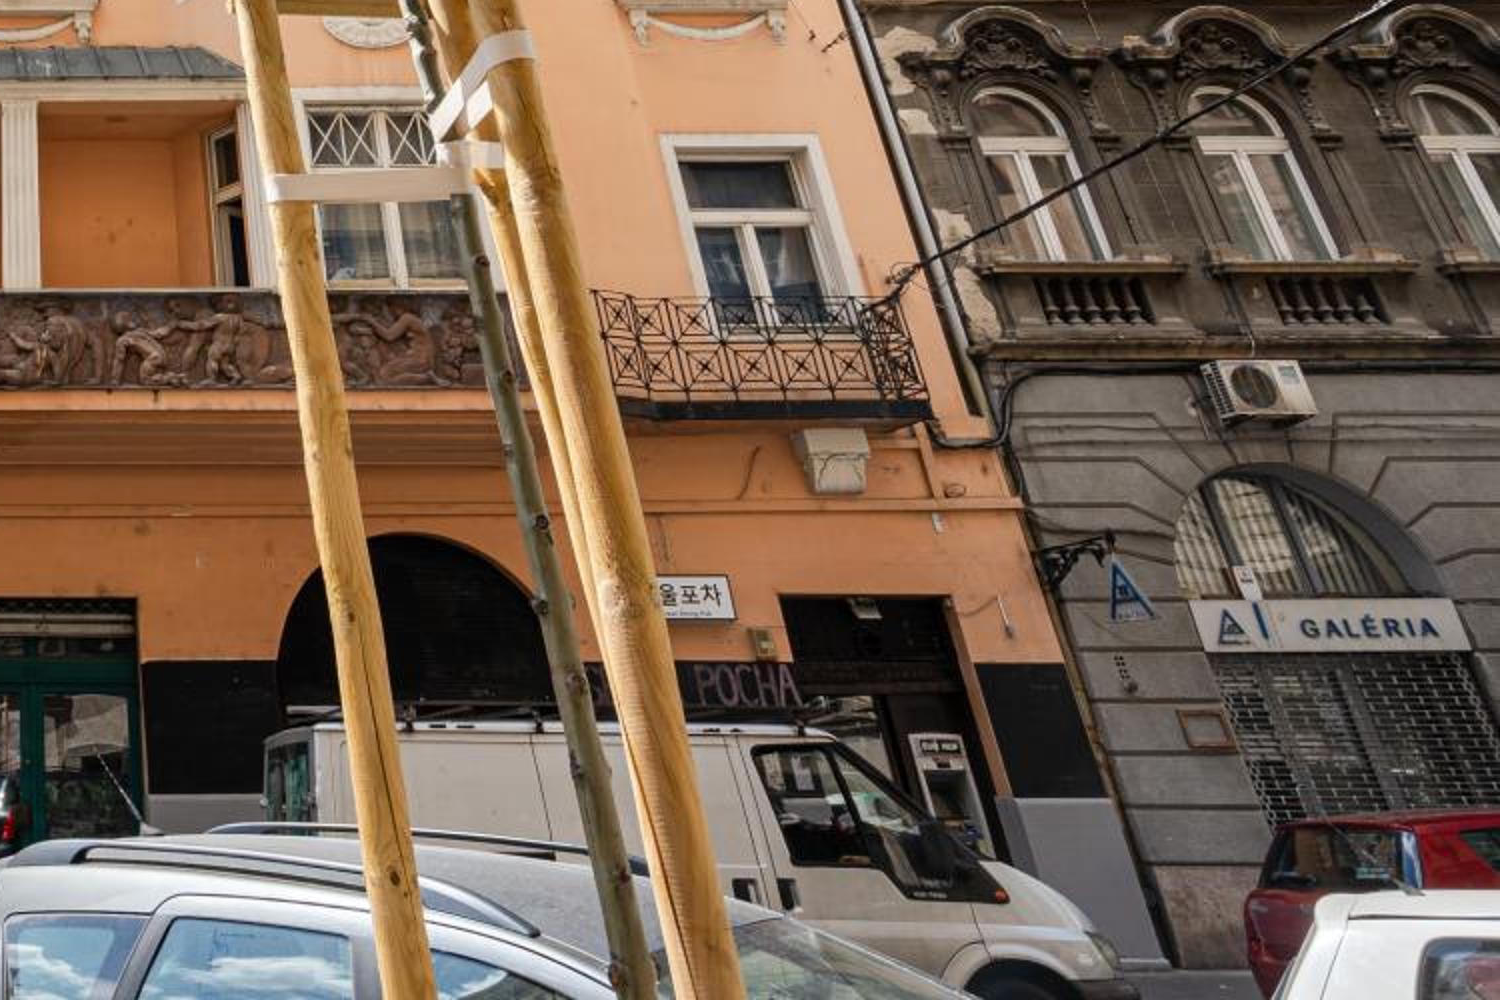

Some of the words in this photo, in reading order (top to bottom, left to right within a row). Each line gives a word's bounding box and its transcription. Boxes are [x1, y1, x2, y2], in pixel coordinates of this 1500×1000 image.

[660, 583, 721, 607] 울포차
[1299, 614, 1440, 639] GALÉRIA
[694, 664, 803, 708] POCHA
